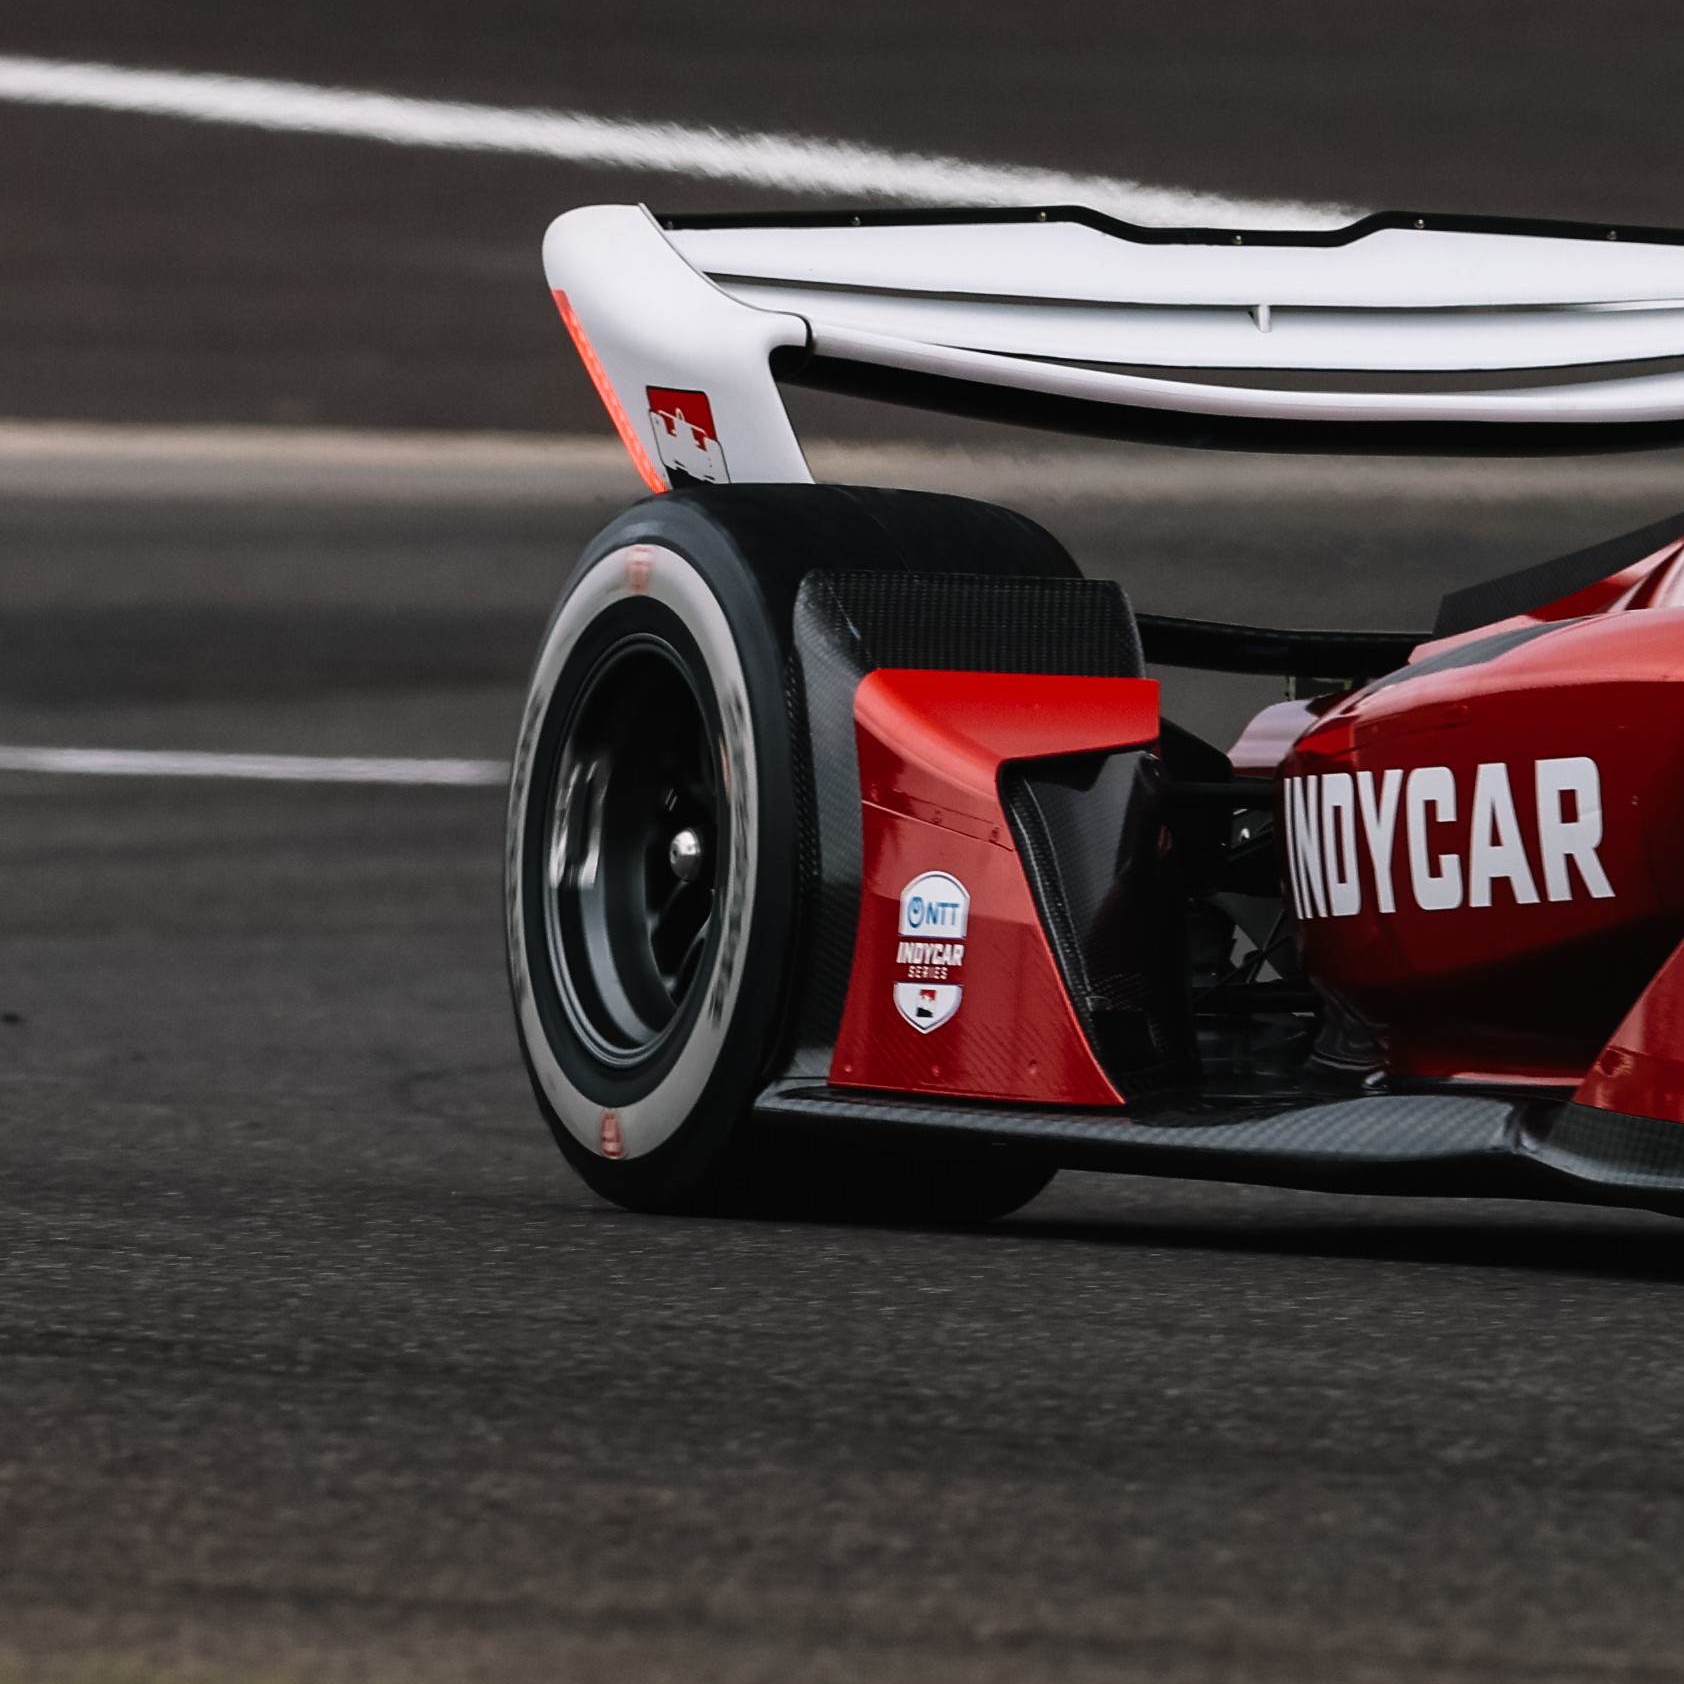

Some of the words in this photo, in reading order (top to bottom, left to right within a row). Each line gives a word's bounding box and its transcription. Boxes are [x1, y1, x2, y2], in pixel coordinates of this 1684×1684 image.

[1284, 756, 1616, 919] INDYCAR
[925, 902, 960, 927] NTT
[896, 942, 965, 966] INDYCAR
[907, 966, 949, 980] SERIES
